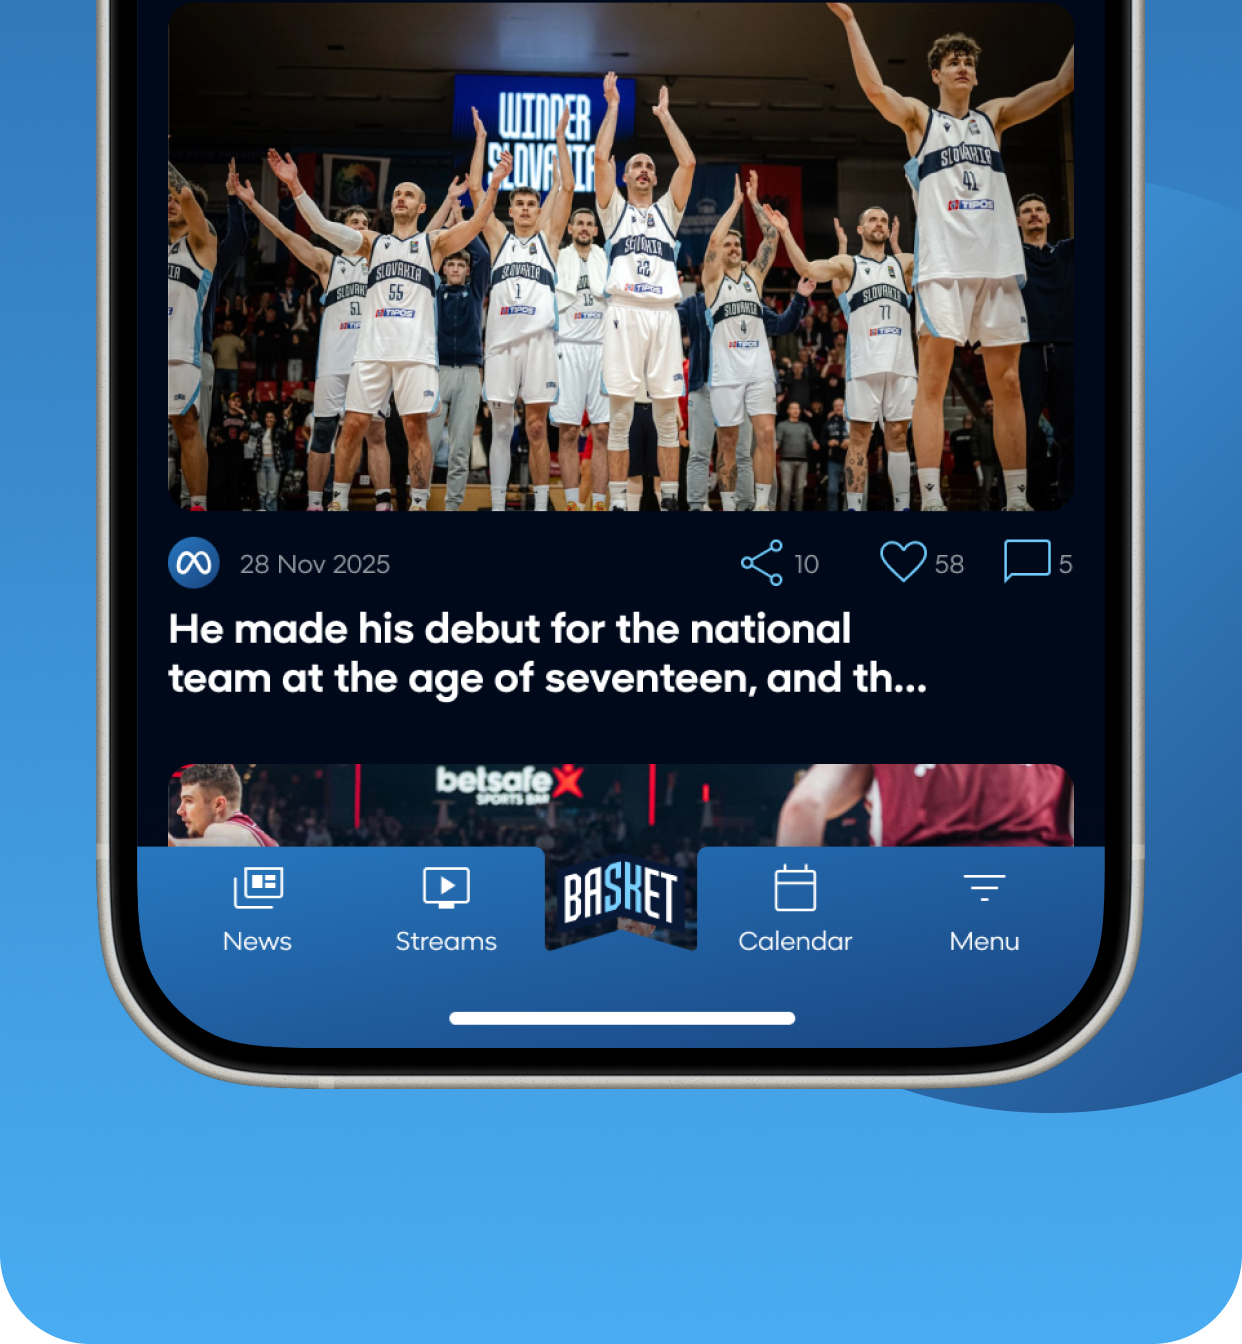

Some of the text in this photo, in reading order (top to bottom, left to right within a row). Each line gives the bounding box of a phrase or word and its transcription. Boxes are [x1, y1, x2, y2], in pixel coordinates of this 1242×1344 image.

[940, 144, 992, 167] SLOVAKIA
[487, 142, 596, 192] SLOVAIA
[963, 171, 979, 191] 41
[961, 200, 993, 210] TIPOS
[375, 261, 422, 282] SLOVAKIA
[637, 260, 651, 277] 22
[388, 283, 404, 302] 55
[515, 283, 521, 299] 1
[863, 284, 901, 304] SLOVAKIA
[350, 301, 362, 316] 51
[385, 308, 414, 318] TIPOS
[723, 301, 759, 317] SLOVAKIA
[879, 304, 891, 320] 77
[740, 319, 747, 335] 4
[240, 554, 391, 574] 28 Nov 2025
[794, 554, 820, 574] 10
[935, 554, 964, 574] 58
[1059, 554, 1073, 574] 5
[169, 610, 851, 645] He made his debut for the national
[167, 663, 271, 694] team
[282, 663, 324, 694] at
[333, 659, 399, 694] the
[408, 669, 484, 704] age
[493, 659, 535, 694] of
[545, 663, 758, 698] seventeen,
[766, 659, 842, 694] and
[436, 765, 553, 793] betsafe
[476, 793, 523, 805] SPORTS
[563, 860, 678, 924] BASKET
[223, 930, 293, 952] News
[395, 929, 498, 952] Streams
[738, 928, 853, 952] Calendar
[950, 930, 1020, 952] Menu
